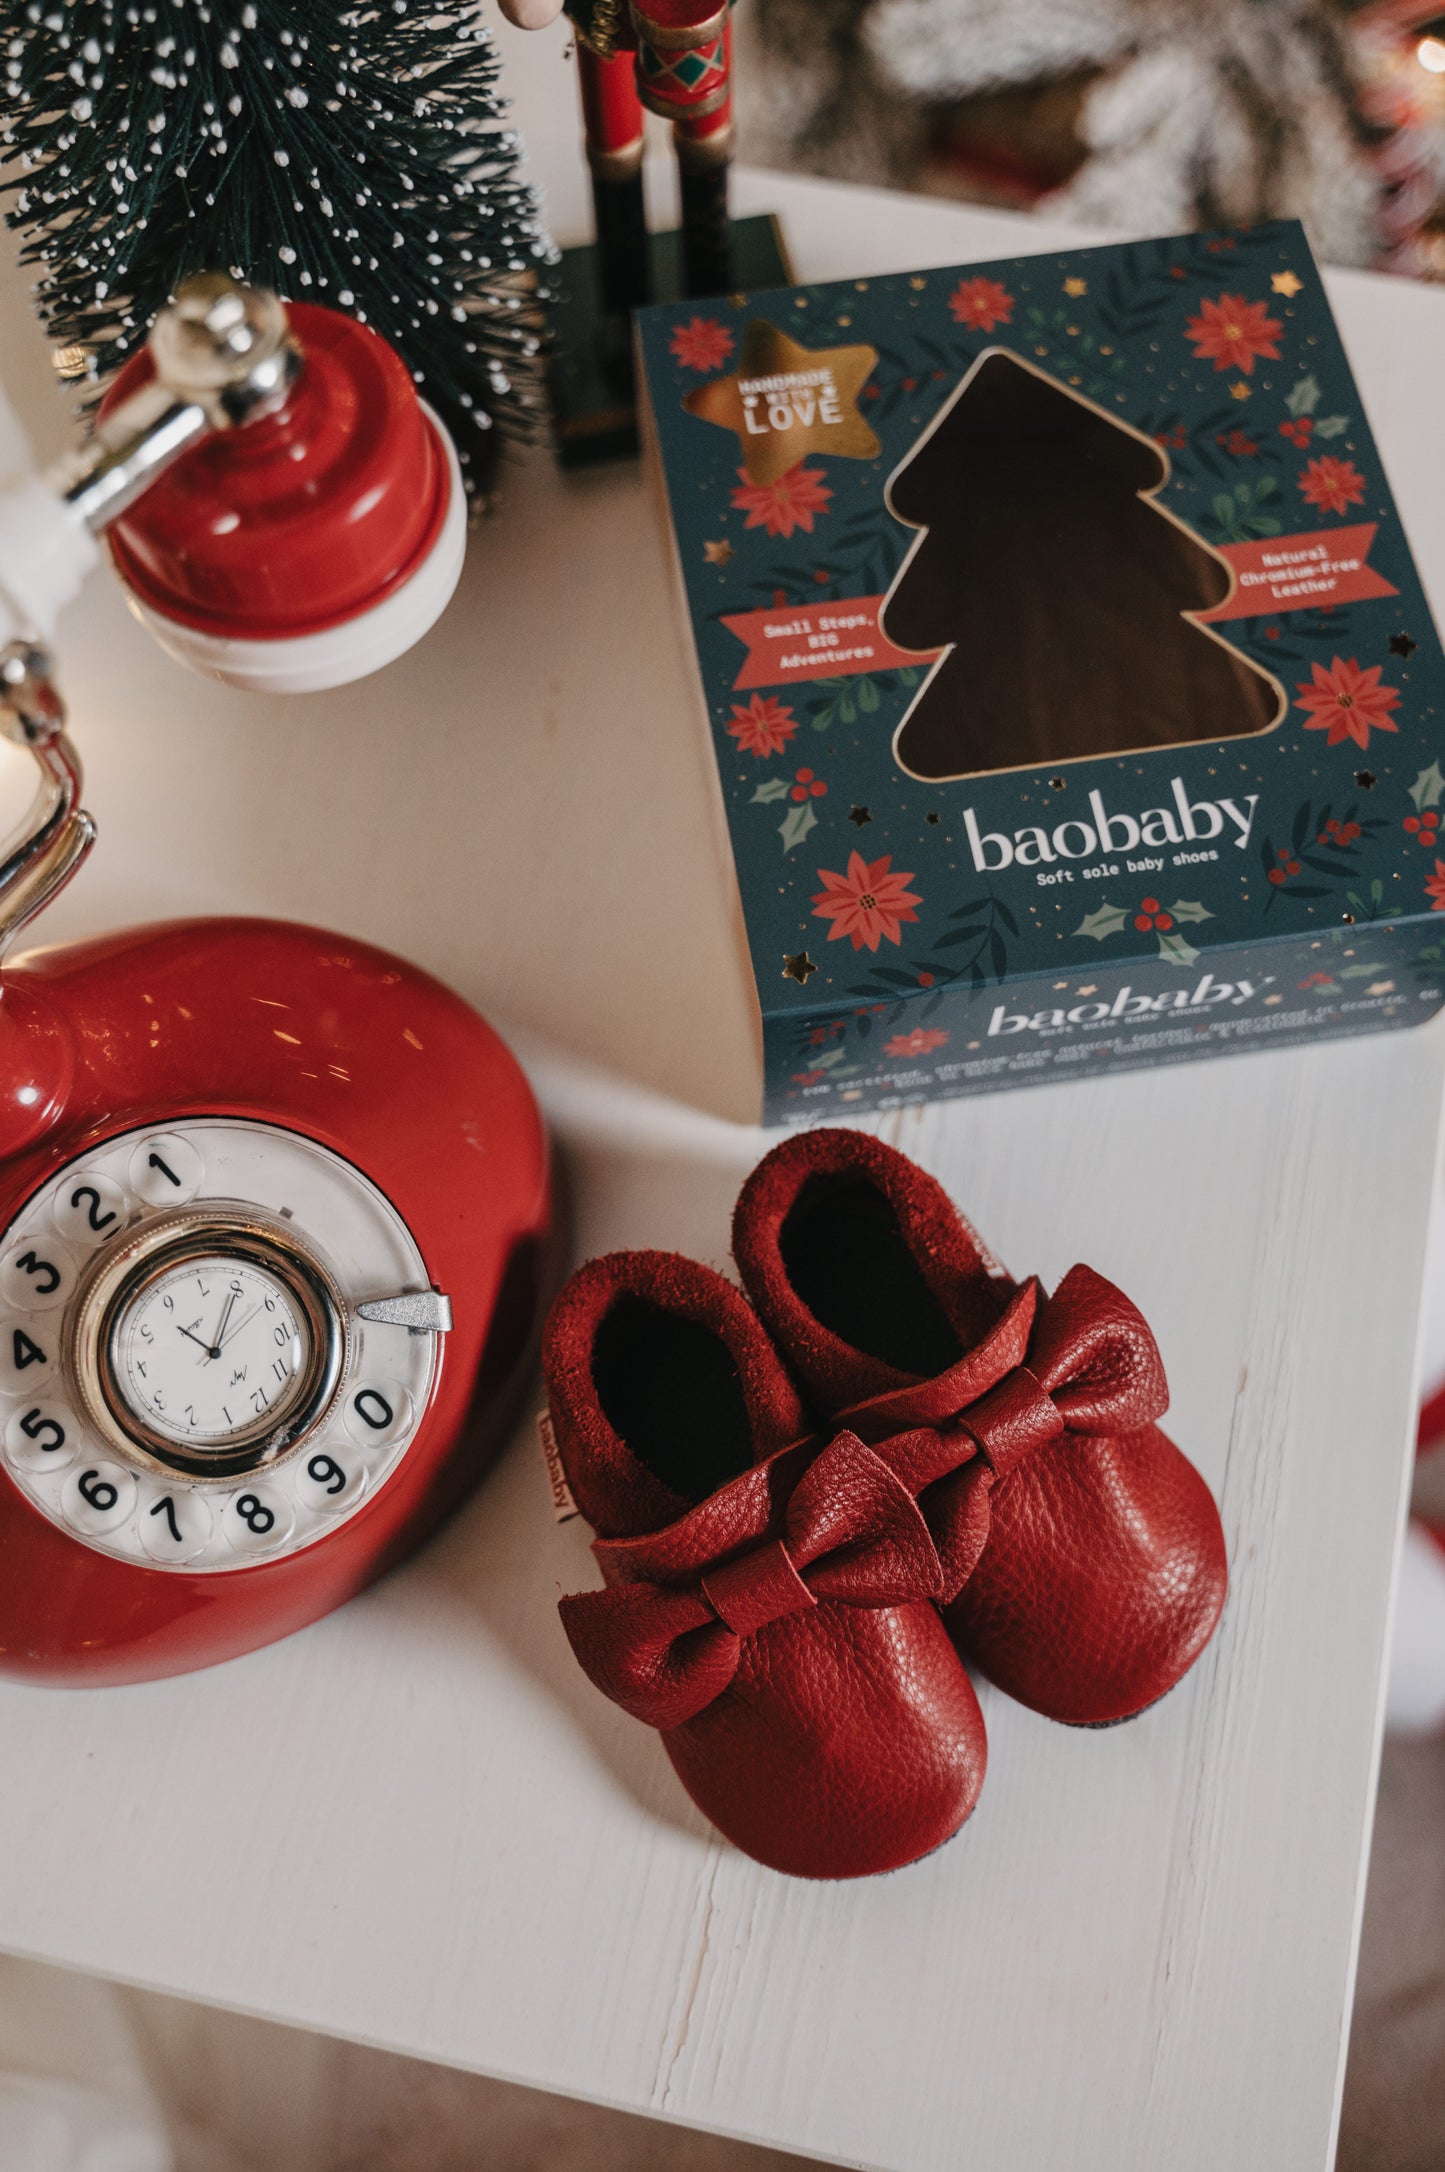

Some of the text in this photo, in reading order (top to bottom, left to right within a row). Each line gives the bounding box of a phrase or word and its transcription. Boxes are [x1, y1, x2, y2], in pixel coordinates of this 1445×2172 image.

[738, 368, 833, 394] HANDMADE
[743, 400, 844, 435] LOVE
[1261, 545, 1328, 567] Natural
[1239, 558, 1361, 587] Chromium-Free
[1271, 577, 1337, 598] Leather
[763, 618, 812, 639] Small
[807, 631, 839, 649] BIG
[779, 645, 875, 669] Adventures
[962, 776, 1259, 872] baobaby
[1036, 848, 1219, 886] Soft sole baby shoes
[987, 973, 1277, 1037] baobaby
[149, 1153, 181, 1187] 1
[71, 1187, 117, 1231] 2
[16, 1251, 61, 1294] 3
[197, 1279, 210, 1297] 7
[230, 1280, 244, 1299] 8
[163, 1295, 174, 1313] 6
[264, 1295, 276, 1313] 9
[141, 1324, 154, 1344] 5
[274, 1322, 291, 1347] 10
[13, 1329, 47, 1370] 4
[136, 1360, 147, 1378] 4
[272, 1358, 289, 1382] 11
[153, 1390, 167, 1411] 3
[250, 1387, 270, 1413] 12
[354, 1389, 393, 1429] 0
[185, 1405, 199, 1426] 2
[222, 1406, 233, 1425] 1
[20, 1408, 65, 1452] 5
[307, 1455, 347, 1494] 9
[78, 1470, 118, 1511] 6
[151, 1497, 183, 1542] 7
[236, 1494, 275, 1534] 8
